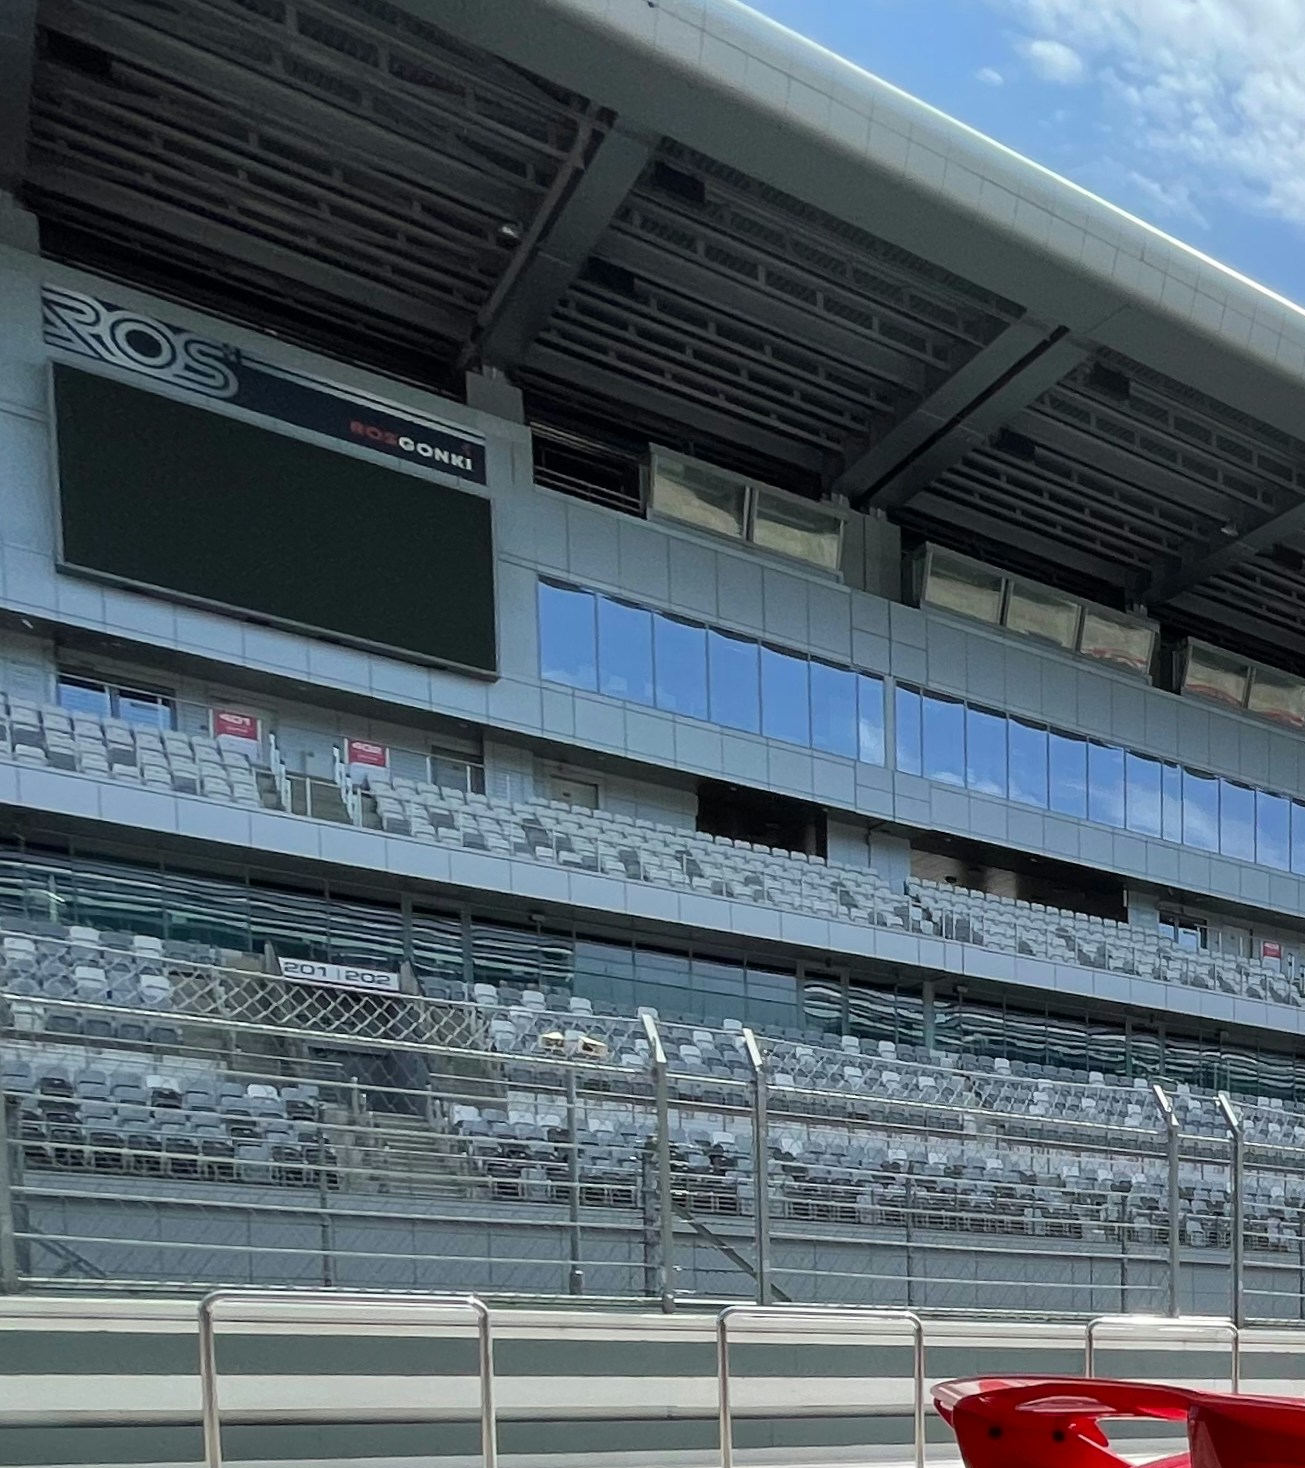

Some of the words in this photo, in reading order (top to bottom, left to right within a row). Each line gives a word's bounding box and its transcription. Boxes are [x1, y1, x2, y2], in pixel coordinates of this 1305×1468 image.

[350, 421, 473, 470] ROSGONKI
[284, 962, 327, 977] 201
[345, 970, 391, 985] 202
